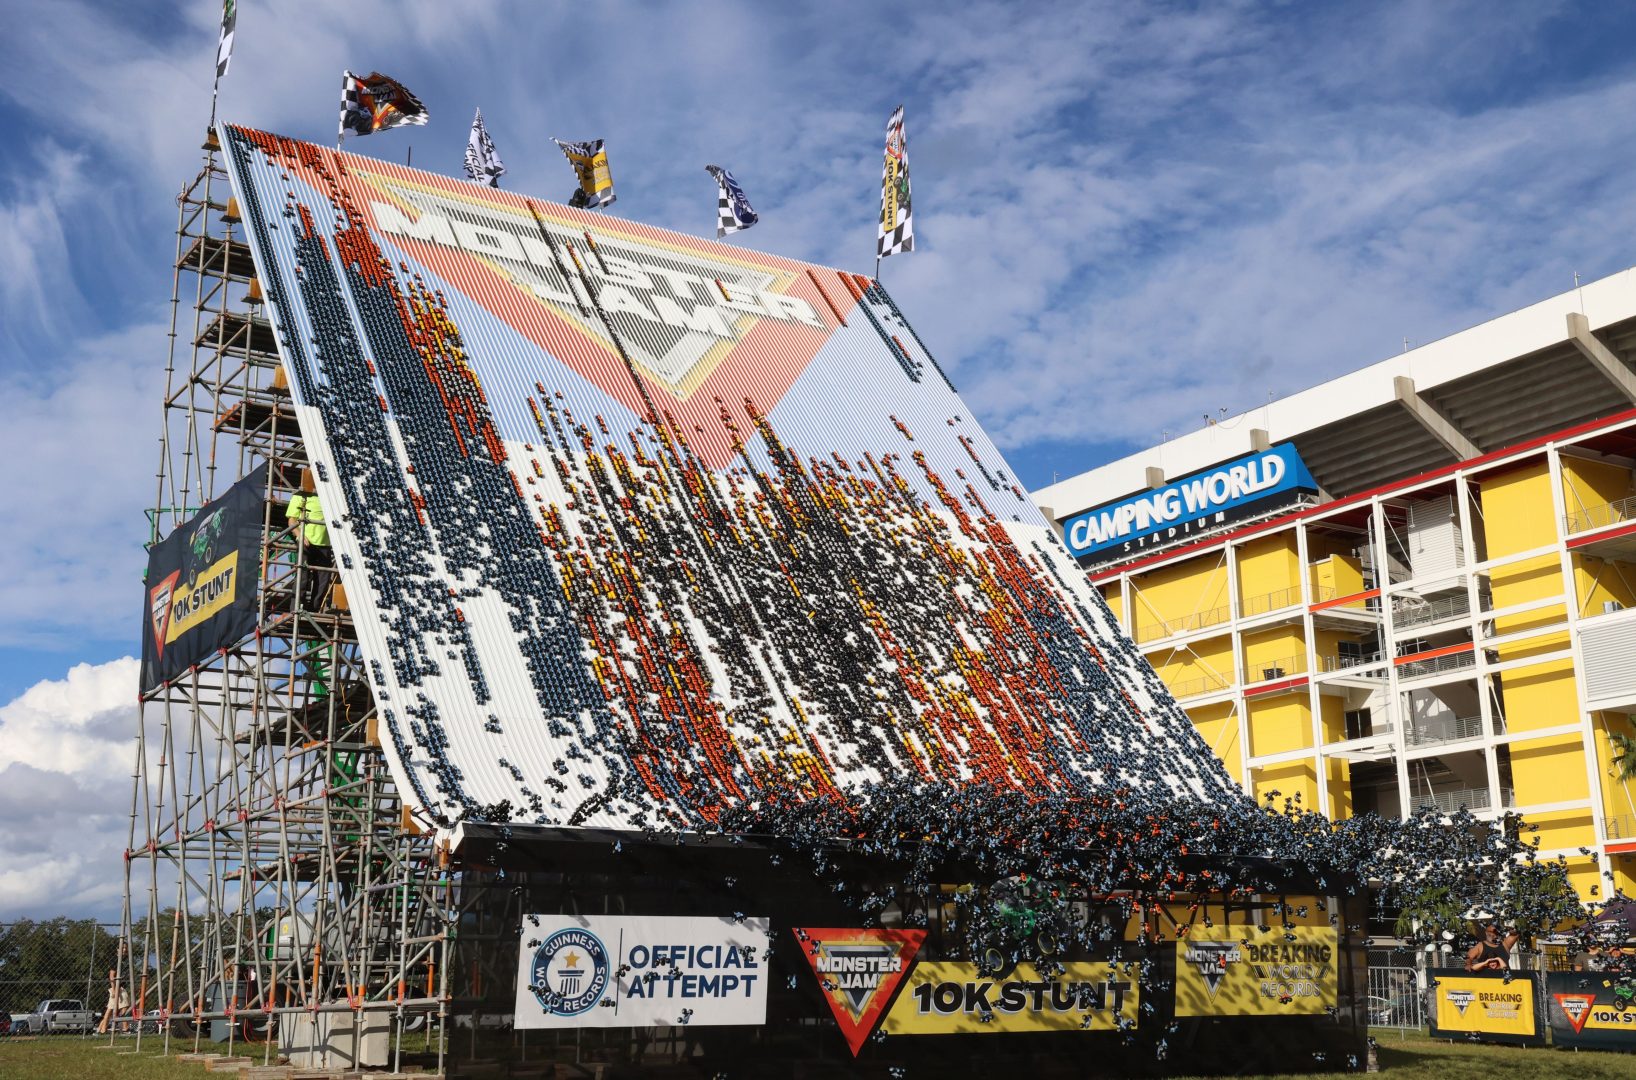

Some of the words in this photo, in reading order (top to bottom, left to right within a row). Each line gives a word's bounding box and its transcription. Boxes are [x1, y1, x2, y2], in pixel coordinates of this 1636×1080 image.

[369, 200, 827, 333] MONSTER
[1070, 488, 1182, 550] CAMPING
[1181, 454, 1286, 513] WORLD
[1123, 511, 1226, 552] STADIUM
[174, 594, 191, 623] 10K
[193, 567, 233, 611] STUNT
[545, 933, 601, 956] GUINNESS
[1249, 944, 1332, 963] BREAKING
[628, 944, 759, 969] OFFICIAL
[816, 956, 902, 972] MONSTER
[1185, 949, 1241, 962] MONSTER
[1200, 962, 1226, 975] JAM
[1267, 964, 1316, 979] WORLD
[563, 966, 606, 1011] RECORDS
[626, 974, 758, 998] ATTEMPT
[840, 973, 878, 988] JAM
[1260, 981, 1321, 998] RECORDS
[913, 981, 994, 1012] 10K
[1000, 981, 1132, 1011] STUNT
[1479, 992, 1523, 1002] BREAKING
[1593, 1012, 1620, 1022] 10K
